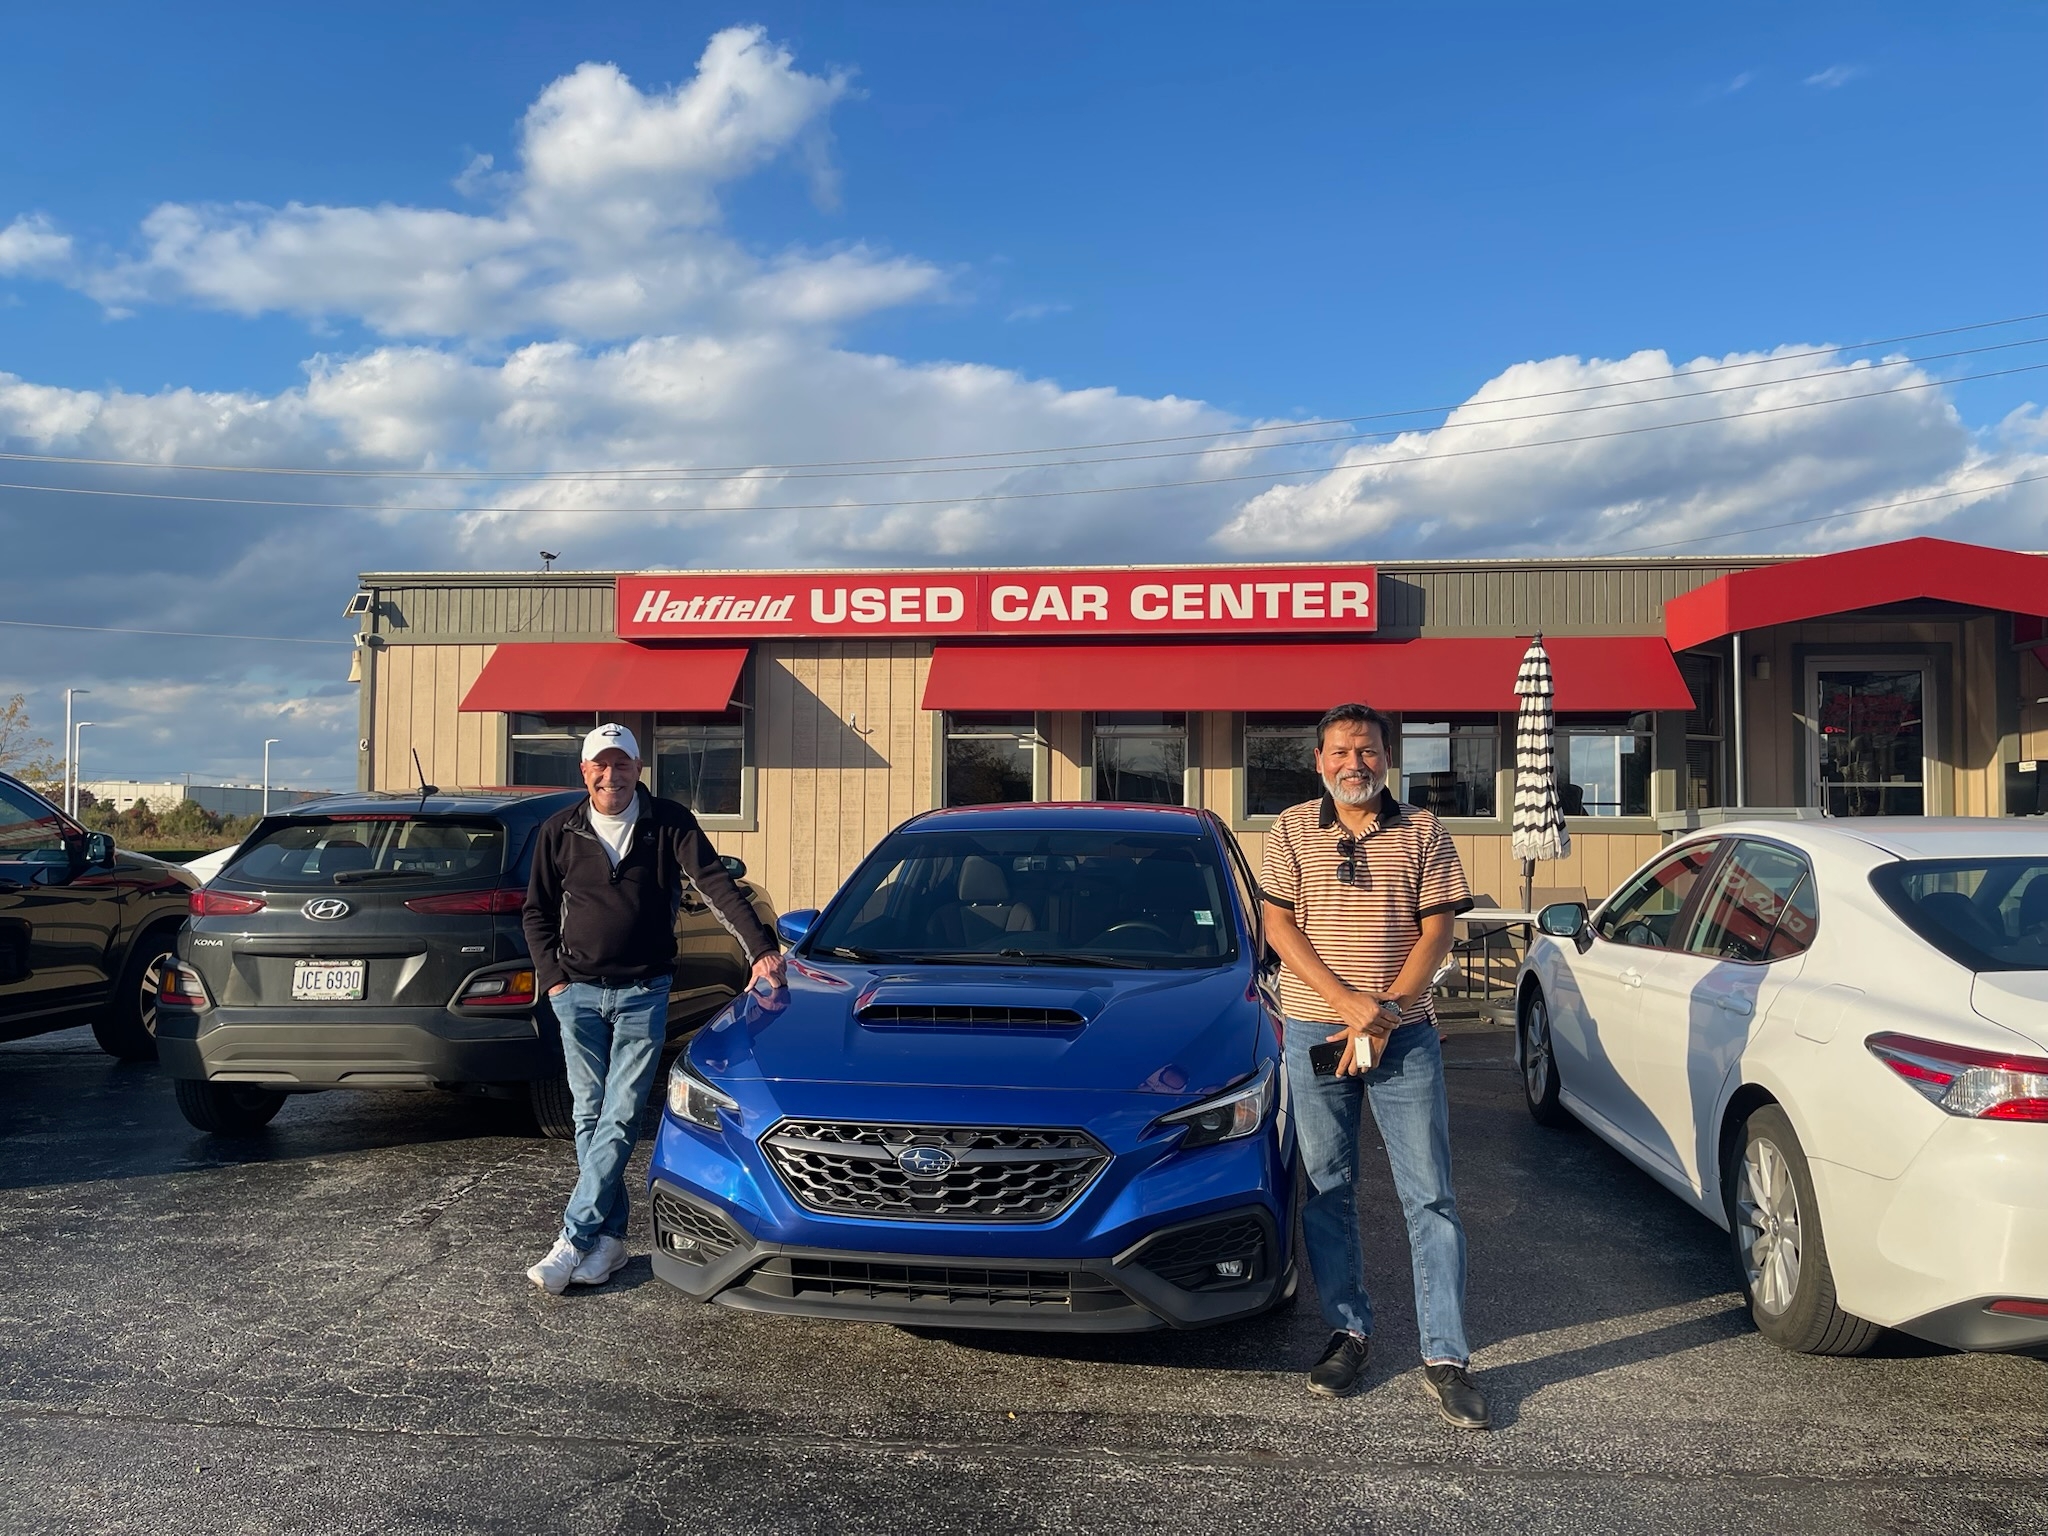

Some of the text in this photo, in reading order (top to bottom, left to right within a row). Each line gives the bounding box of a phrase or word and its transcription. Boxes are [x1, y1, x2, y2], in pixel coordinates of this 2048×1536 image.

[632, 582, 1370, 624] Hatfield USED CAR CENTER
[193, 938, 224, 947] KONA
[297, 970, 360, 989] JCE 6930
